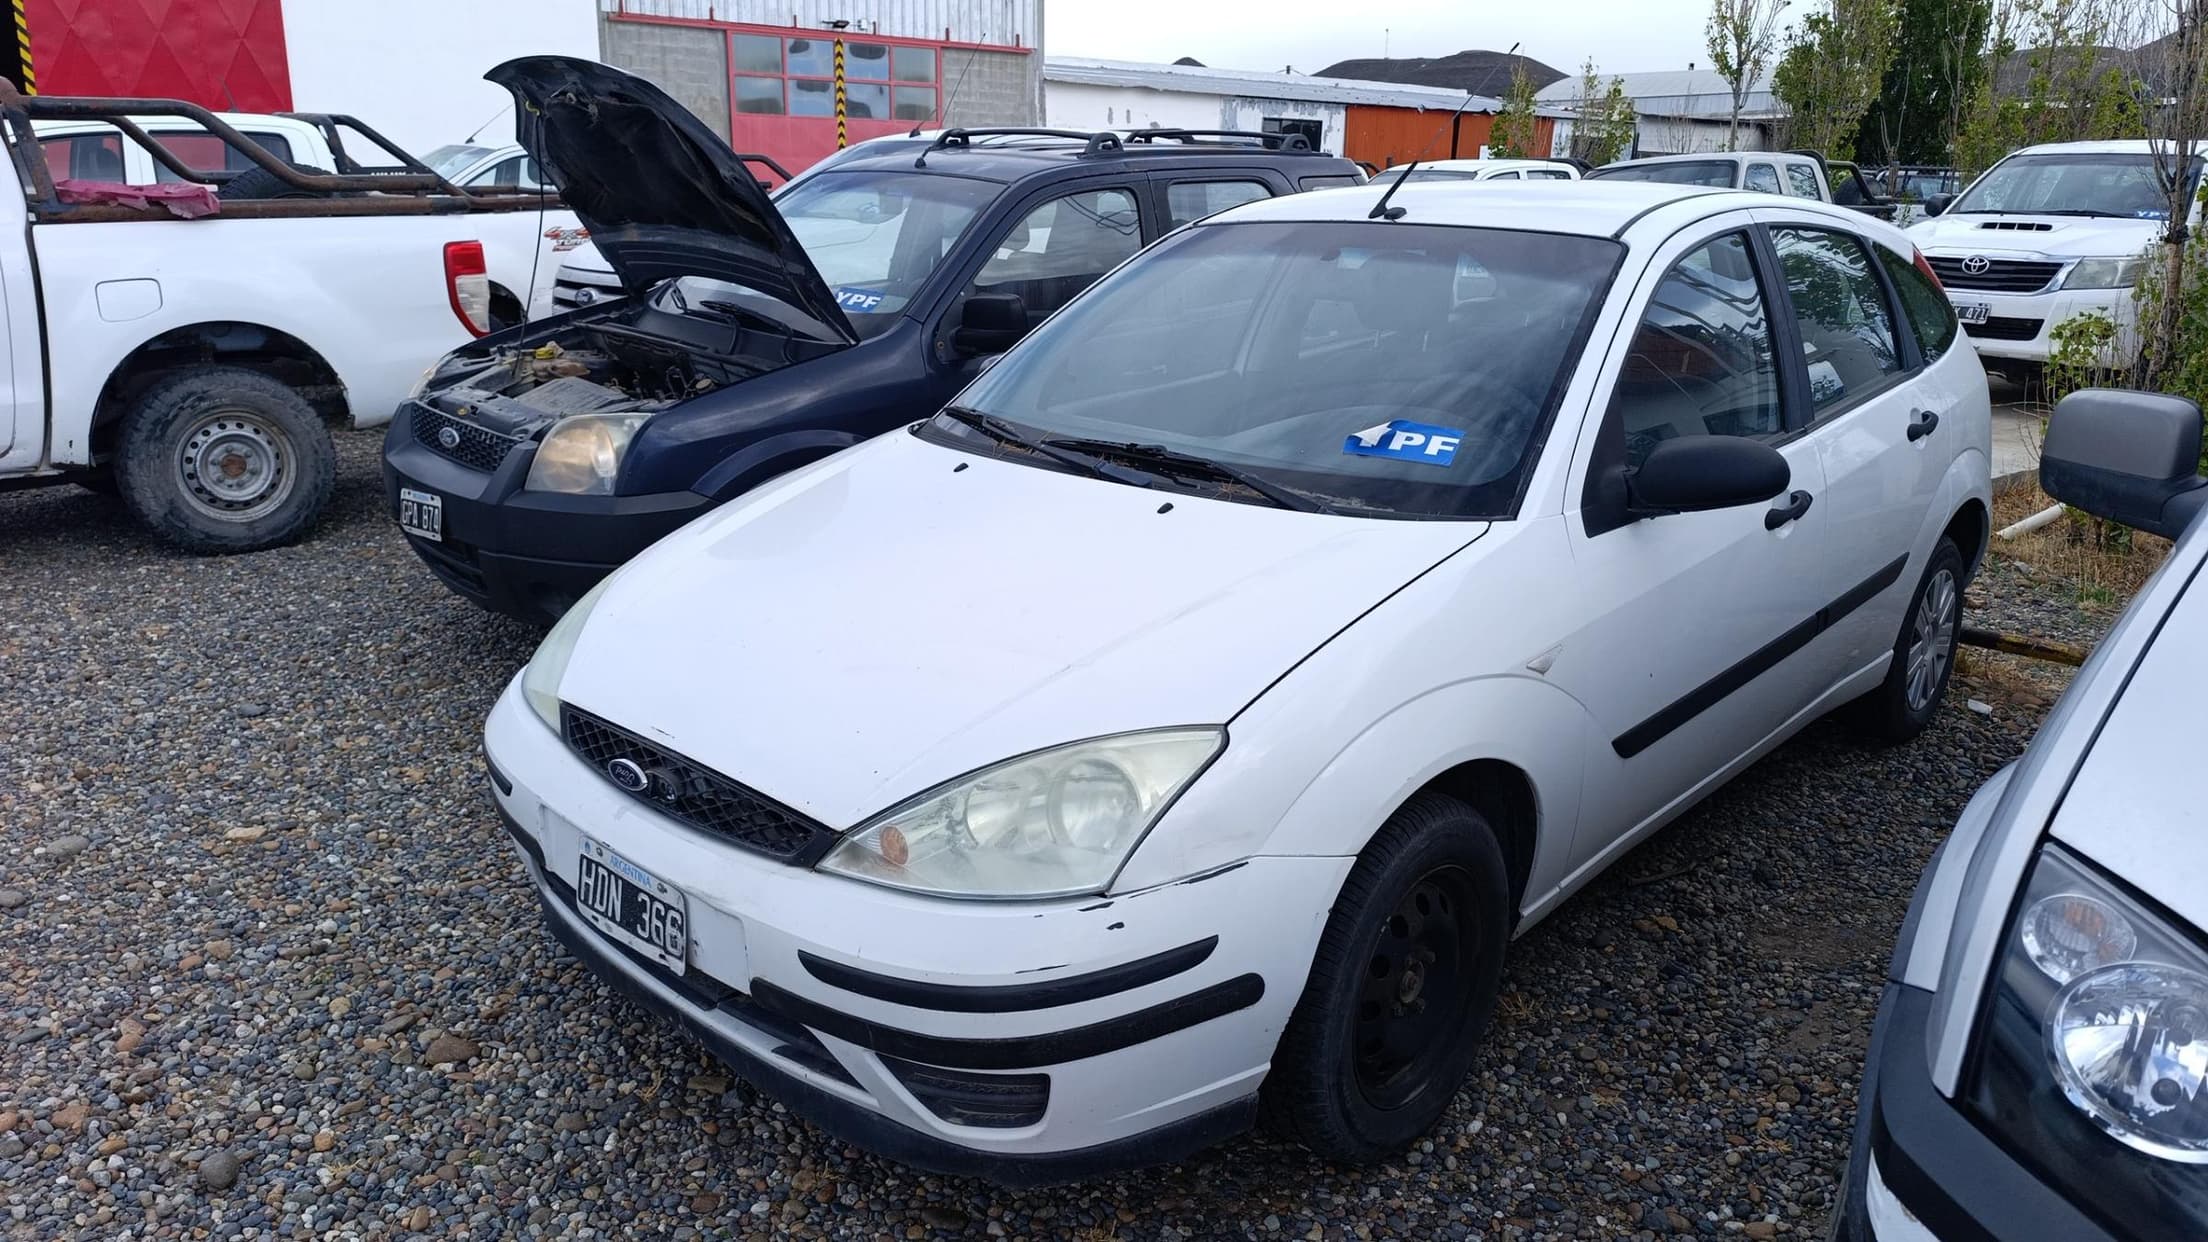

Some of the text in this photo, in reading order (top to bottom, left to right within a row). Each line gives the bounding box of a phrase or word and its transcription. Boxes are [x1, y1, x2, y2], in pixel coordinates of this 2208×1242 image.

[836, 291, 881, 308] YPF
[608, 855, 652, 889] ARGENTINA
[580, 857, 684, 957] HDN 366
